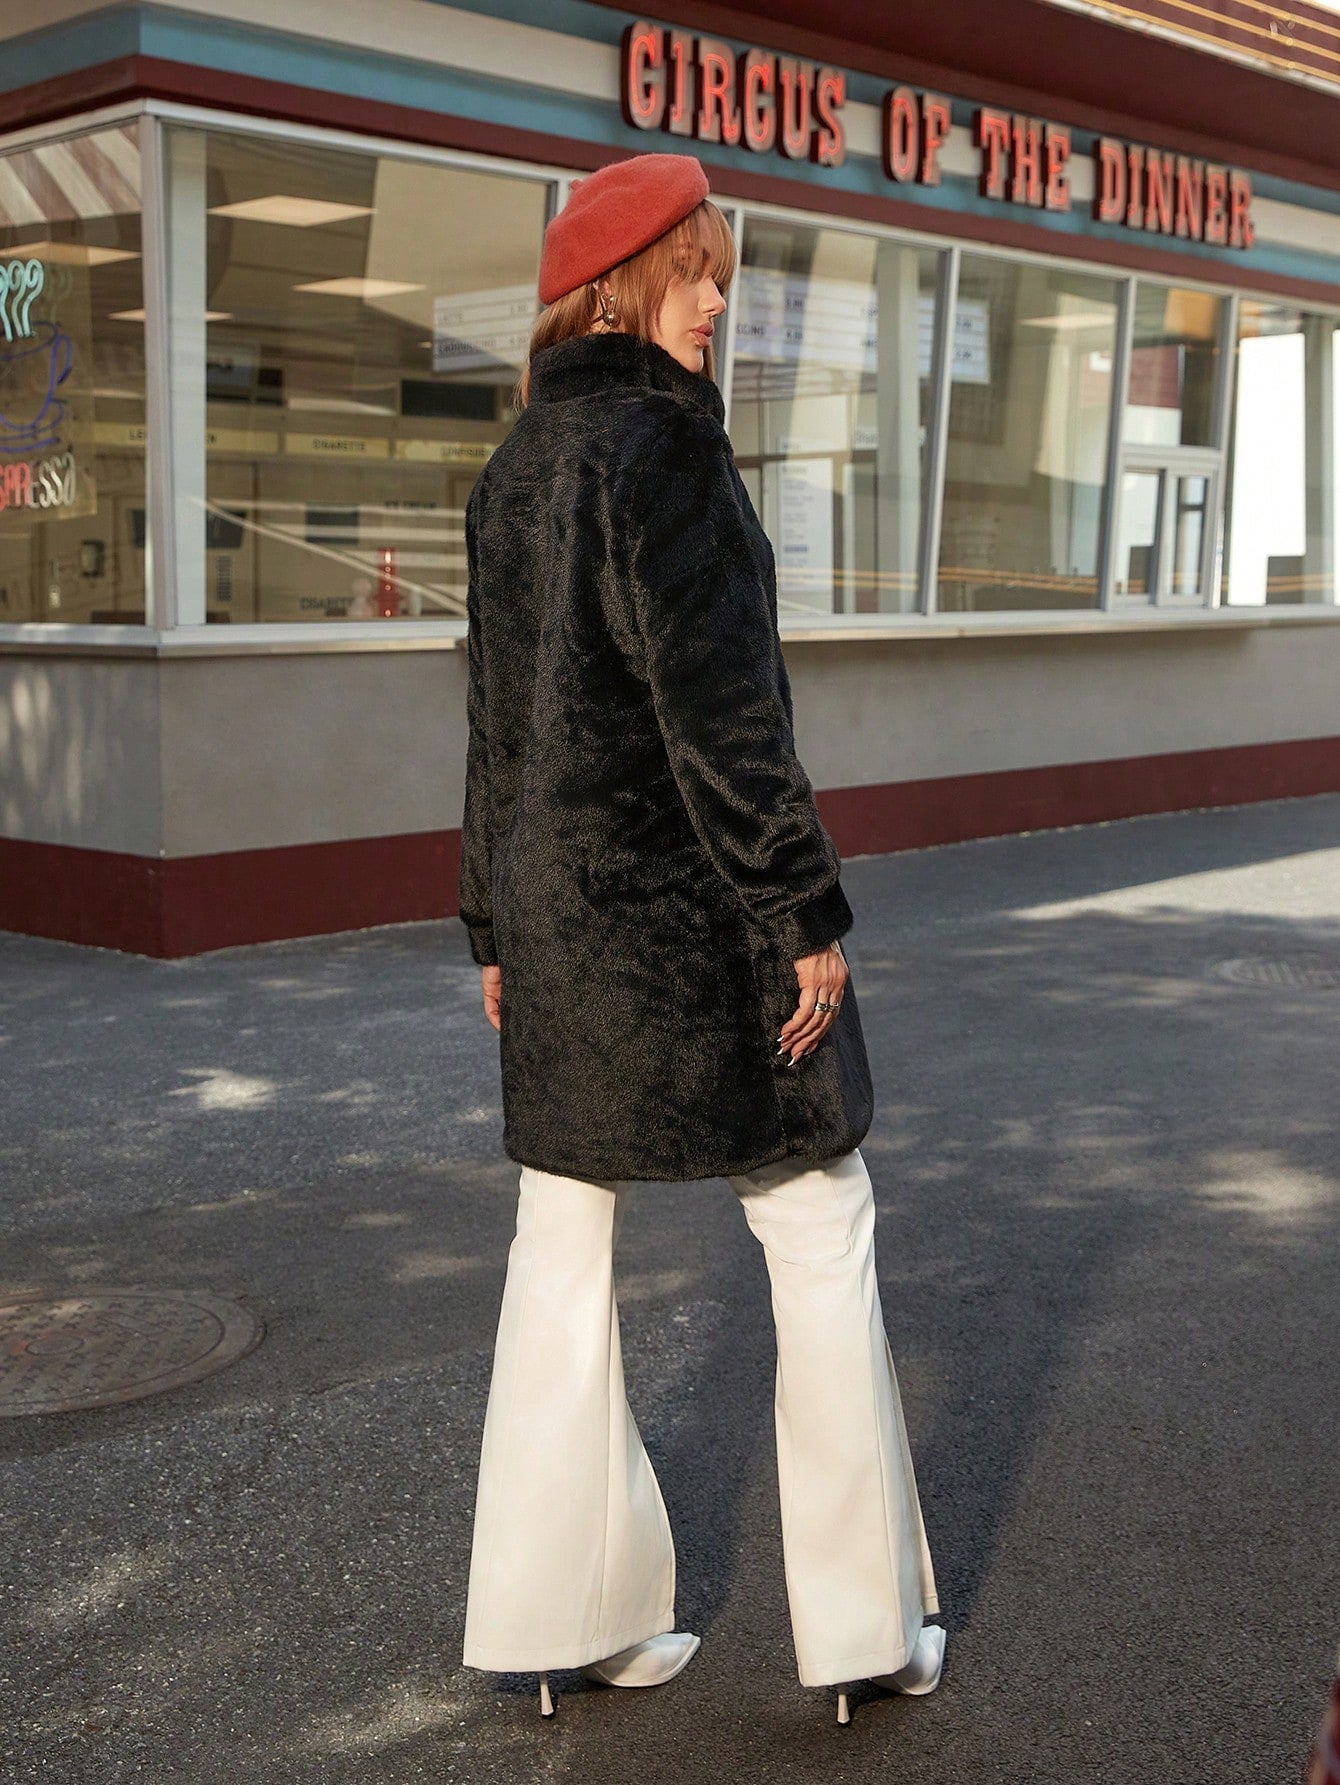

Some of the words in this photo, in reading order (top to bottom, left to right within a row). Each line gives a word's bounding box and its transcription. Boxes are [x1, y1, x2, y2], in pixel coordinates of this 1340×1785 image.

[622, 20, 846, 167] CIRCUS
[883, 85, 952, 187] OF
[974, 106, 1072, 213] THE
[1092, 136, 1255, 250] DINNER
